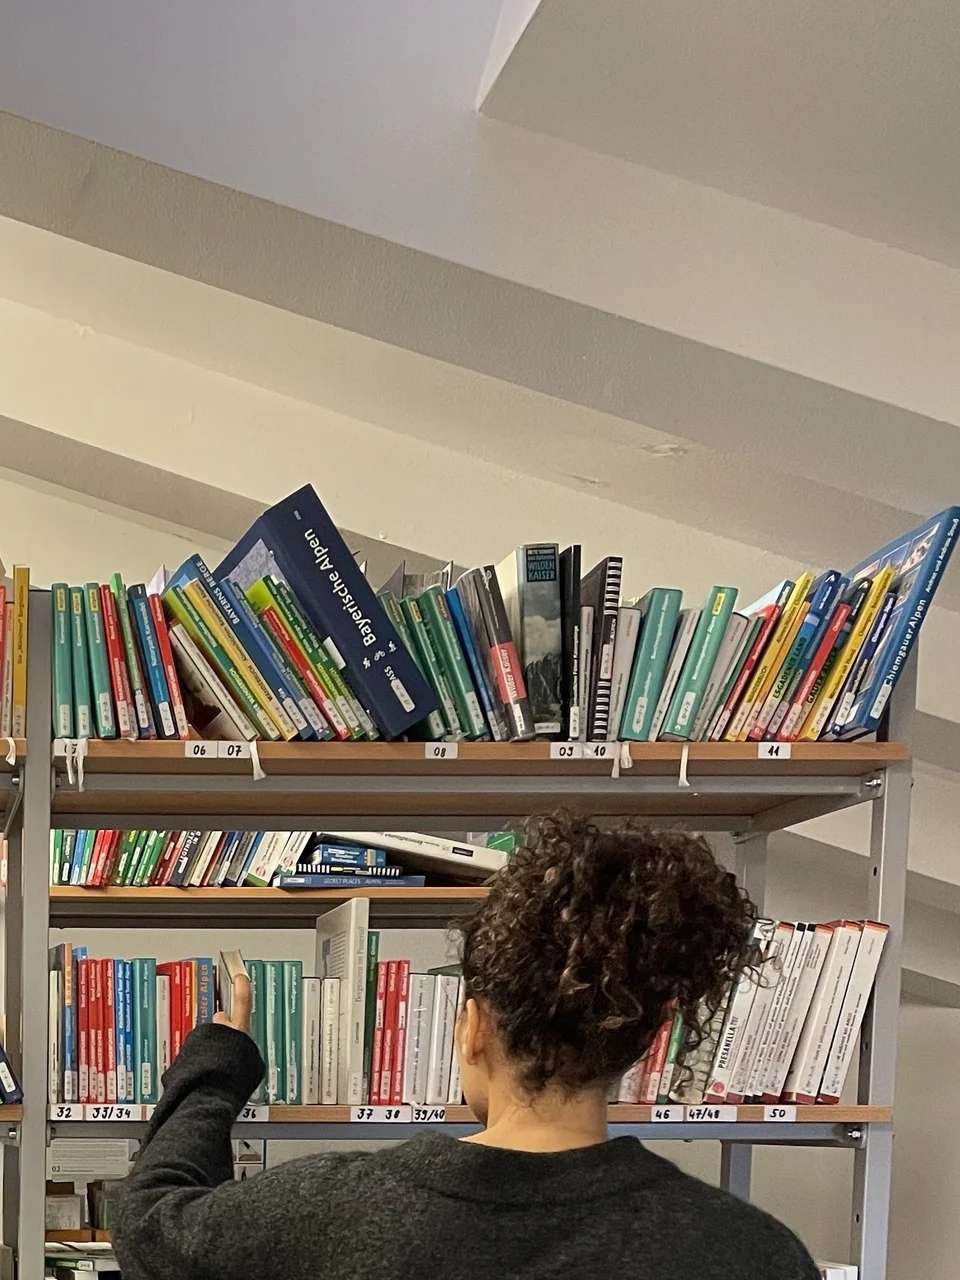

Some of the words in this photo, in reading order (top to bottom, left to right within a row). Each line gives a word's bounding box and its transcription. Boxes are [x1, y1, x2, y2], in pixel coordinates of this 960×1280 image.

[303, 528, 337, 572] Alpen
[528, 561, 555, 570] WILDEN
[196, 561, 217, 587] BERGE
[528, 571, 556, 580] KAISER
[212, 588, 240, 625] BAYERNS
[328, 573, 377, 647] Bayerische
[139, 602, 150, 635] Karwendel
[883, 628, 913, 686] Chiemgauer
[909, 600, 926, 628] Alpen
[147, 635, 157, 667] Naturpark
[500, 649, 512, 672] Kaiser
[248, 665, 273, 701] WANDERBUCH
[506, 674, 518, 698] Wilder
[193, 745, 206, 755] 06
[227, 745, 241, 756] 07
[434, 747, 446, 757] 08
[594, 745, 606, 756] 10
[768, 746, 779, 756] 11
[718, 1029, 736, 1069] PRESANELLA
[57, 1107, 72, 1117] 32
[92, 1106, 131, 1119] 33/34
[243, 1108, 256, 1118] 36
[357, 1108, 373, 1119] 37
[385, 1109, 400, 1119] 38
[415, 1109, 445, 1120] 39/40
[655, 1109, 670, 1119] 46
[689, 1109, 720, 1119] 47/48
[770, 1109, 786, 1118] 50
